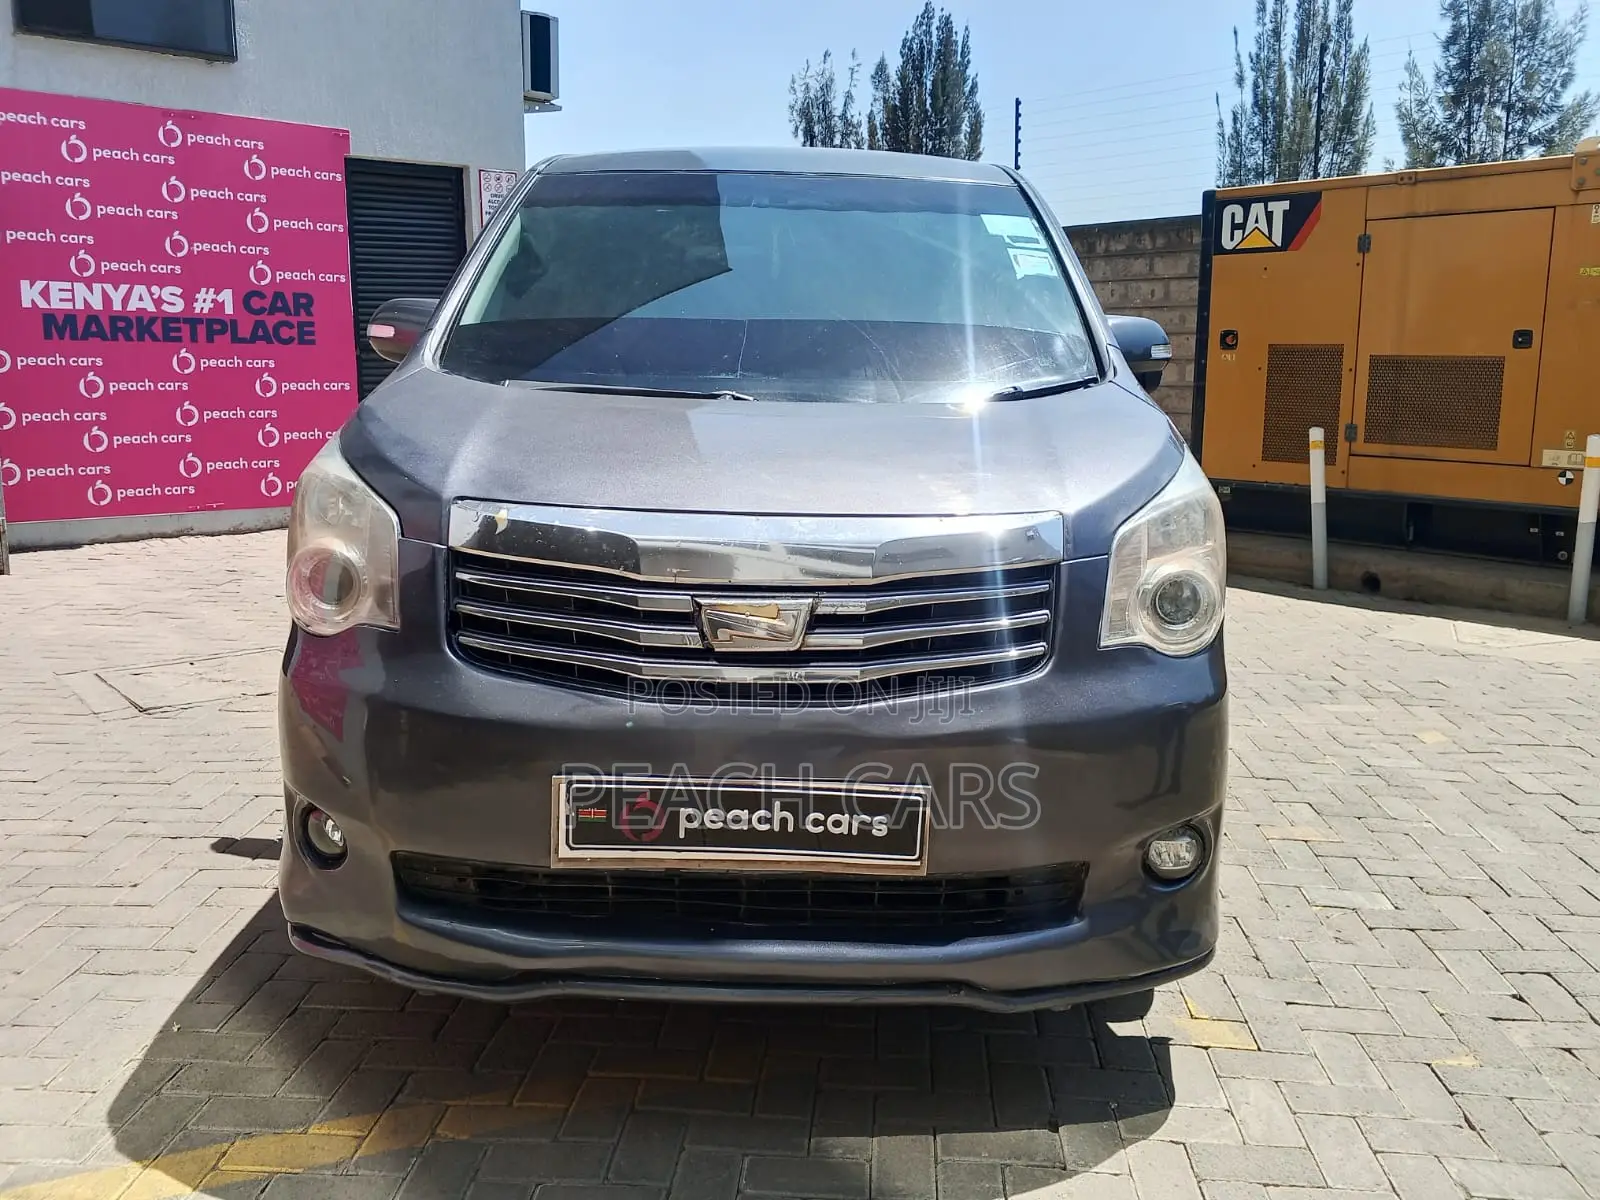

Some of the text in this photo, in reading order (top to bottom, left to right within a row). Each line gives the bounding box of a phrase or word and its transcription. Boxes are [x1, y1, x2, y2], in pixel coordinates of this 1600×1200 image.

[0, 111, 86, 129] peach cars
[187, 133, 265, 150] peach cars
[92, 147, 176, 165] peach cars
[0, 170, 91, 188] peach cars
[270, 165, 342, 182] peach cars
[190, 187, 267, 203] peach cars
[96, 204, 179, 220] peach cars
[273, 216, 344, 233] peach cars
[1221, 199, 1290, 250] CAT
[6, 229, 95, 245] peach cars
[193, 240, 270, 256] peach cars
[100, 260, 182, 275] peach cars
[275, 269, 346, 284] peach cars
[20, 279, 315, 317] KENYA'S #1 CAR
[42, 313, 317, 346] MARKETPLACE
[16, 353, 104, 369] peach cars
[200, 355, 275, 371] peach cars
[108, 378, 189, 394] peach cars
[281, 379, 351, 393] peach cars
[21, 408, 107, 426] peach cars
[203, 407, 278, 423] peach cars
[112, 431, 192, 448] peach cars
[283, 427, 323, 444] peach
[26, 463, 111, 481] peach cars
[206, 458, 280, 474] peach cars
[116, 483, 195, 502] peach cars
[679, 800, 889, 839] peach cars
